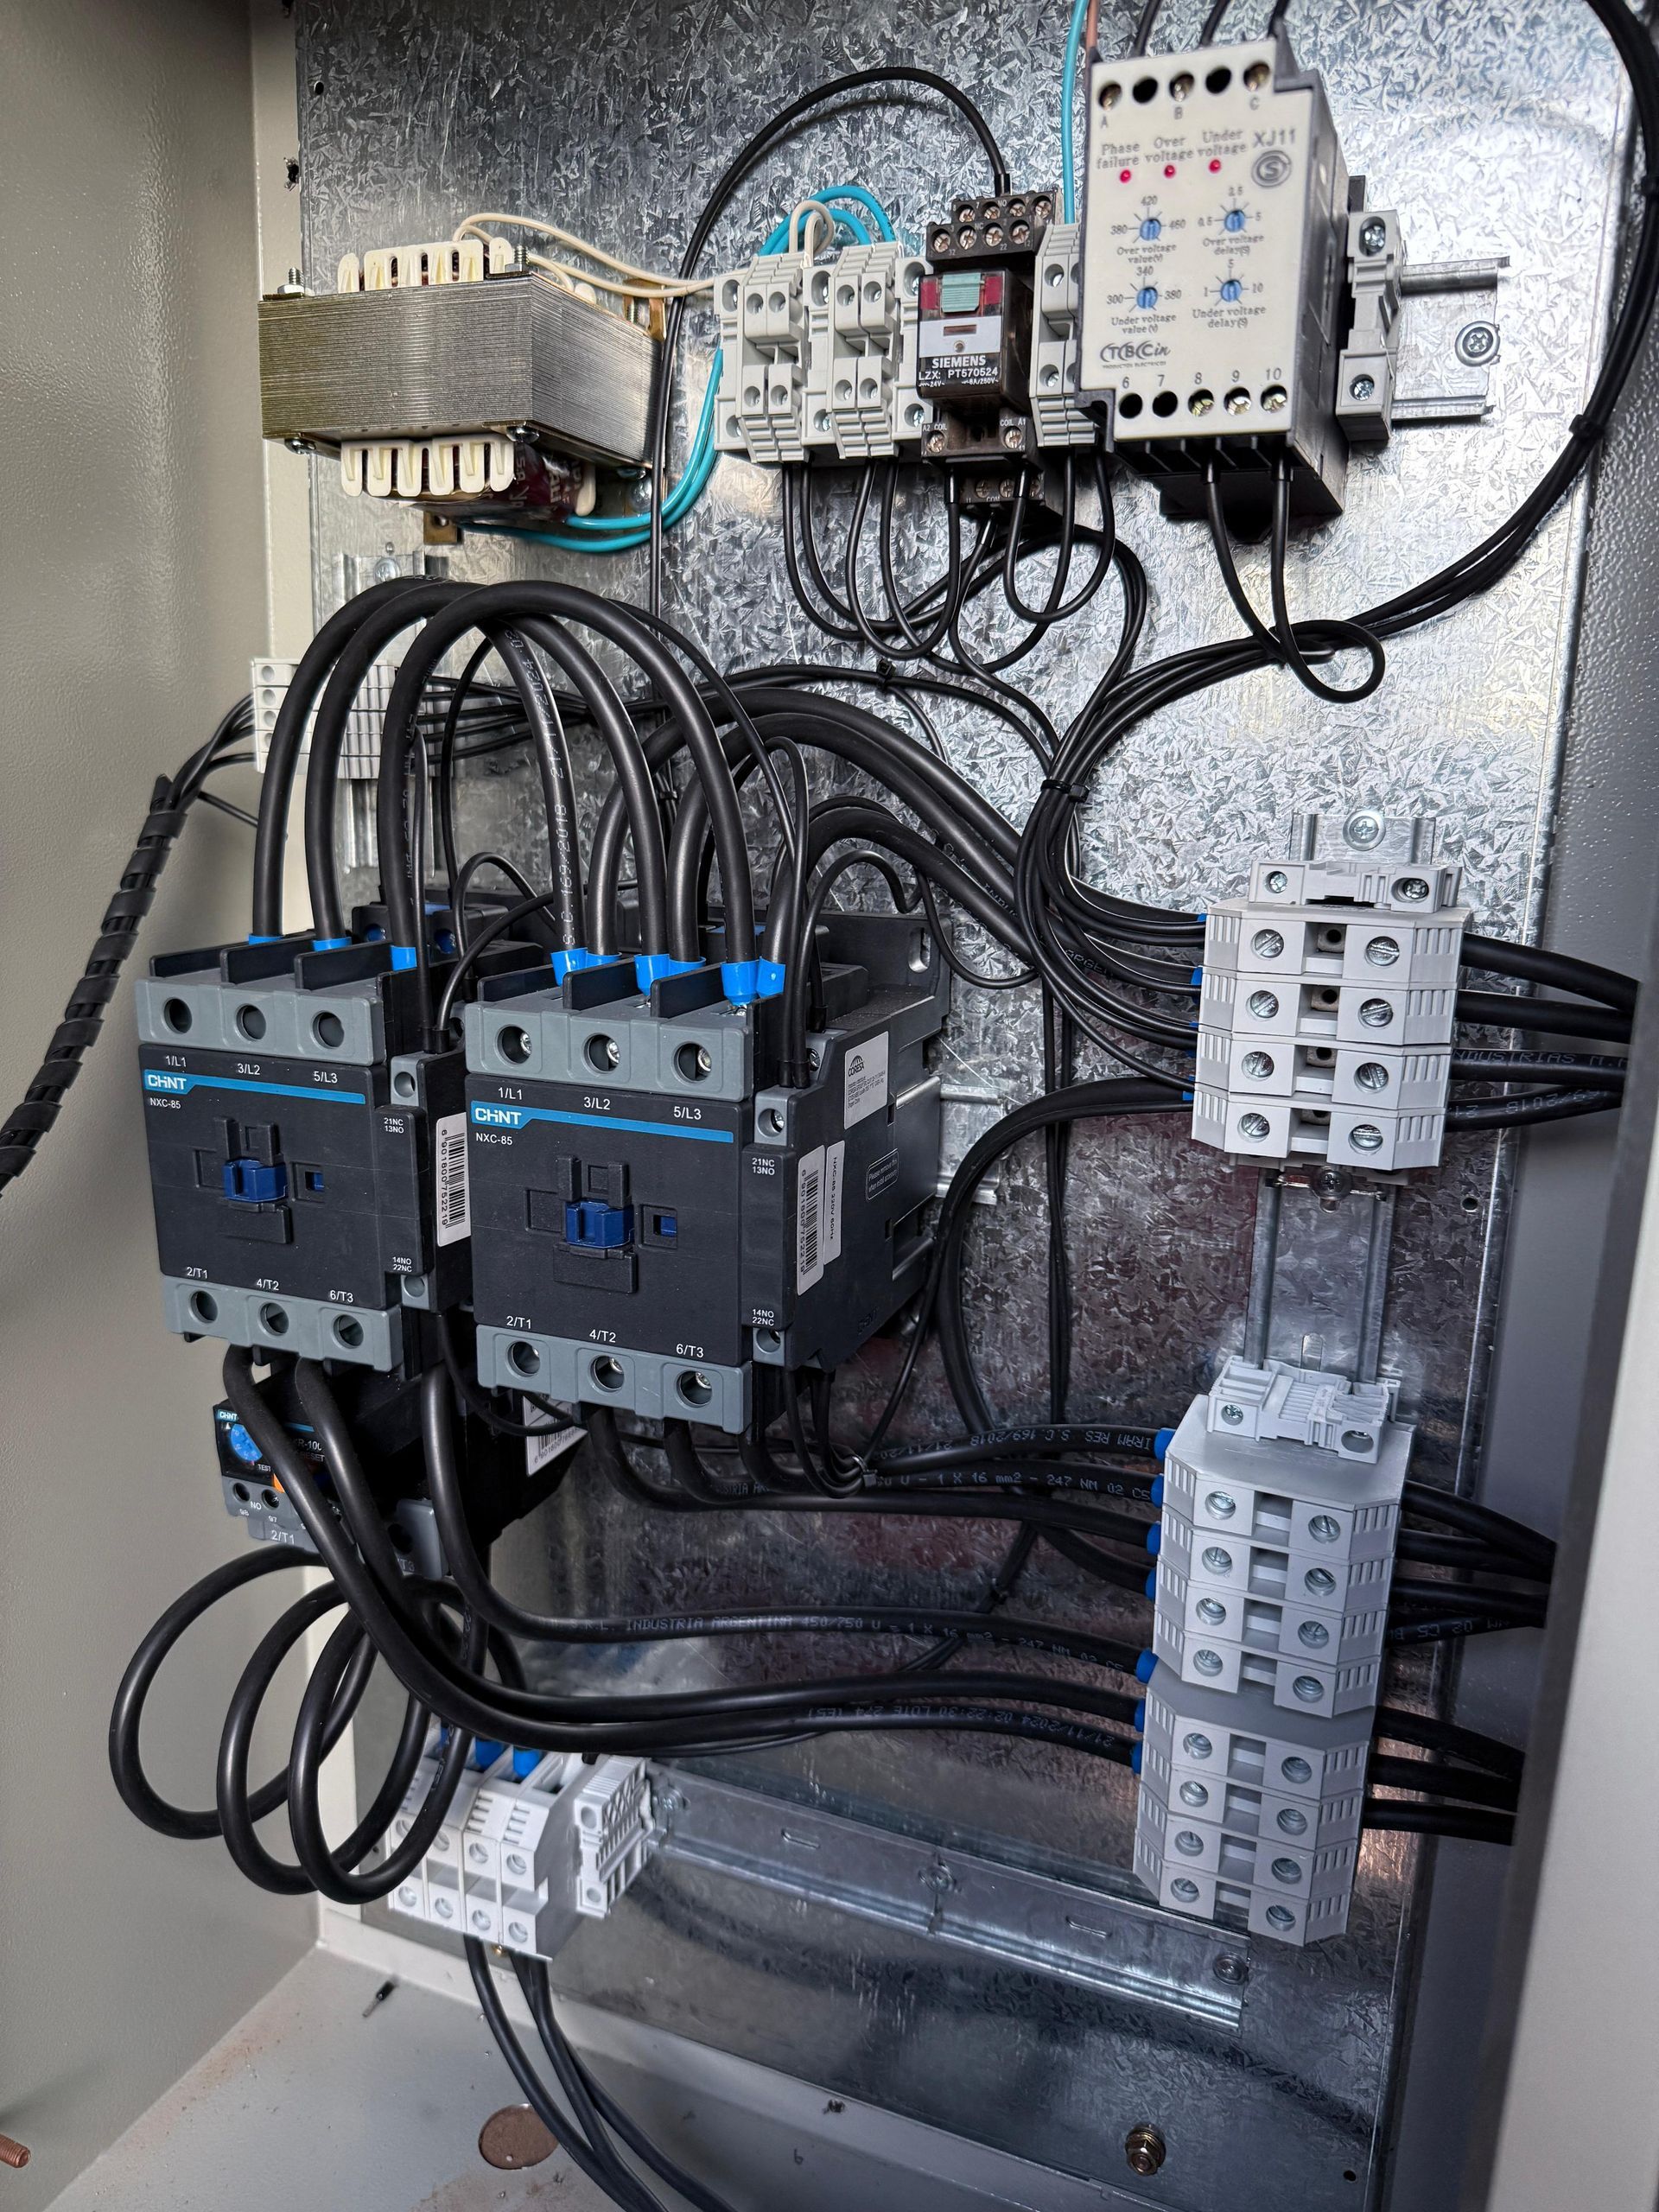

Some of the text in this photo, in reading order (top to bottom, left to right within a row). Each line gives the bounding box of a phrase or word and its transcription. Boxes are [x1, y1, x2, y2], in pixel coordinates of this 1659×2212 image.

[1249, 98, 1260, 110] C
[1174, 107, 1184, 119] B
[1101, 116, 1109, 129] A
[1202, 129, 1243, 143] Under
[1253, 128, 1297, 148] XJ11
[1102, 143, 1141, 156] Phase
[1154, 137, 1187, 149] Over
[1145, 149, 1194, 163] voltage
[1197, 143, 1247, 157] voltage
[1096, 155, 1140, 169] failure
[1141, 195, 1158, 206] 420
[1110, 225, 1128, 235] 380
[1203, 233, 1265, 247] Over voltage
[1116, 243, 1177, 256] Over voltage
[1228, 259, 1234, 269] 5
[1136, 266, 1154, 276] 340
[1164, 289, 1182, 300] 380
[1252, 283, 1263, 294] 10
[1106, 295, 1123, 305] 300
[1192, 305, 1267, 319] Under voltage
[1111, 314, 1177, 327] Under voltage
[932, 355, 987, 369] SIEMENS
[918, 366, 998, 381] LZX: PT570524
[1194, 372, 1202, 385] 8
[1231, 370, 1240, 383] 9
[1266, 367, 1281, 381] 10
[1122, 376, 1129, 389] 6
[1157, 374, 1165, 387] 7
[1018, 417, 1027, 426] A1
[165, 1055, 187, 1068] 1/L1
[237, 1063, 261, 1076] 3/L2
[314, 1071, 338, 1084] 5/L3
[498, 1087, 523, 1100] 1/L1
[149, 1097, 181, 1109] NXC-85
[583, 1096, 611, 1110] 3/L2
[674, 1106, 702, 1121] 5/L3
[384, 1117, 404, 1126] 21NC
[385, 1125, 404, 1134] 13NO
[475, 1132, 513, 1146] NXC-85
[752, 1158, 775, 1167] 21NC
[752, 1166, 775, 1175] 13NO
[392, 1256, 412, 1265] 14NO
[186, 1266, 208, 1279] 2/T1
[392, 1263, 412, 1273] 22NC
[257, 1278, 280, 1291] 4/T2
[330, 1289, 353, 1303] 6/T3
[752, 1309, 775, 1319] 14NO
[506, 1315, 532, 1330] 2/T1
[752, 1317, 775, 1326] 22NC
[589, 1330, 617, 1343] 4/T2
[676, 1344, 704, 1358] 6/T3
[1117, 1434, 1152, 1450] IRAM
[257, 1464, 271, 1472] TEST
[972, 1471, 988, 1484] 16
[1046, 1474, 1072, 1486] 247
[1080, 1478, 1098, 1491] NM
[251, 1501, 262, 1510] NO
[270, 1529, 295, 1545] 2/T1
[626, 1617, 704, 1631] INDUSTRIA
[801, 1616, 863, 1630] 450/750
